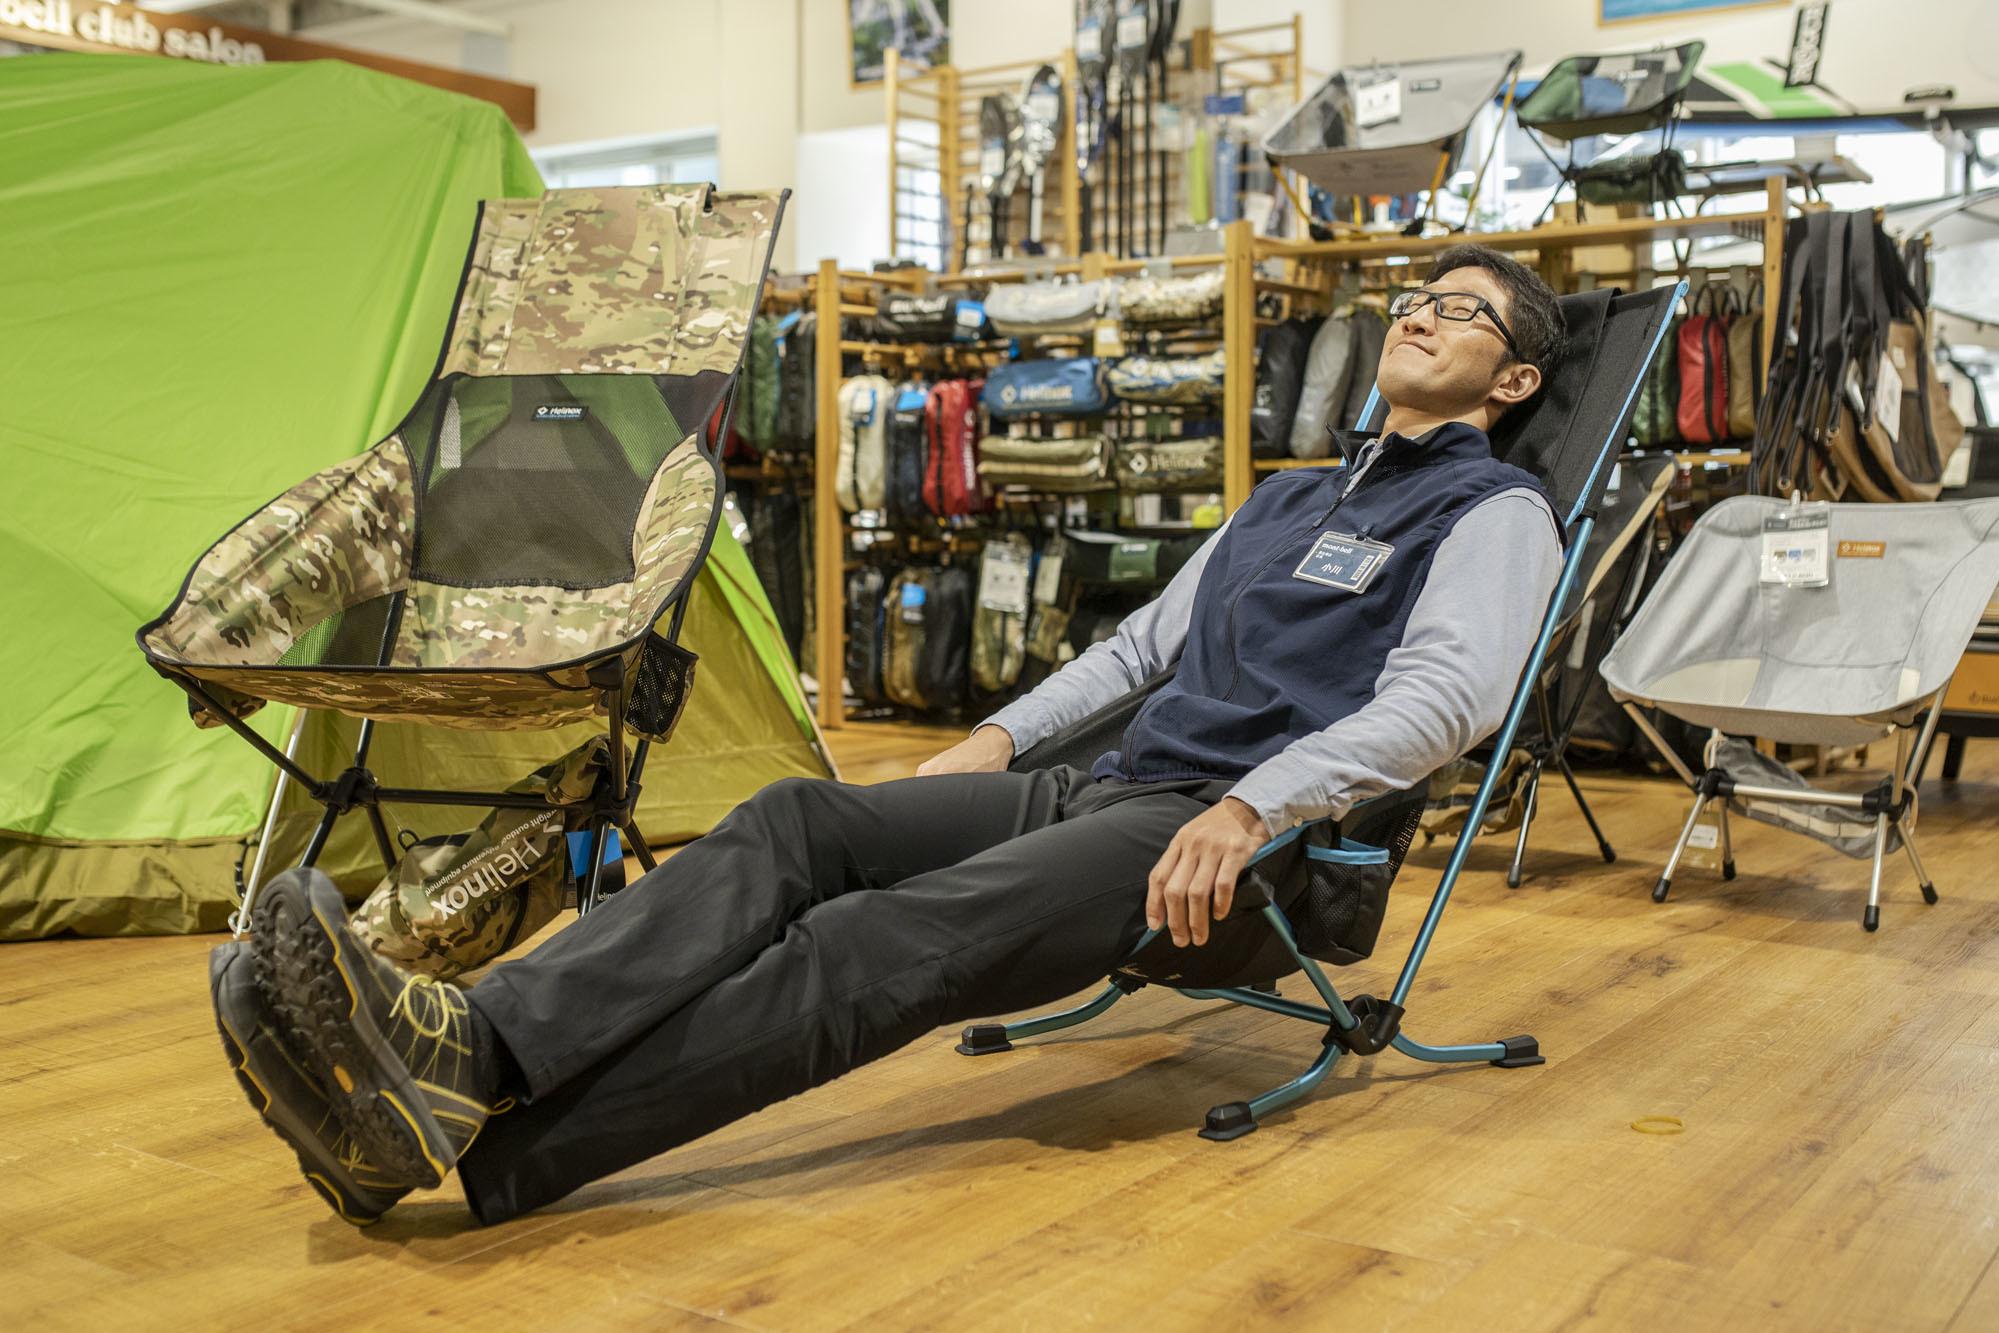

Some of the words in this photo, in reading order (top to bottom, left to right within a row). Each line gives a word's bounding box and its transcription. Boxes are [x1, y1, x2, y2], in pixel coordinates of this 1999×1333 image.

[76, 7, 160, 50] club
[162, 27, 266, 66] salon
[501, 822, 530, 847] outdoor
[425, 868, 462, 897] equipment
[431, 837, 541, 921] Helinox
